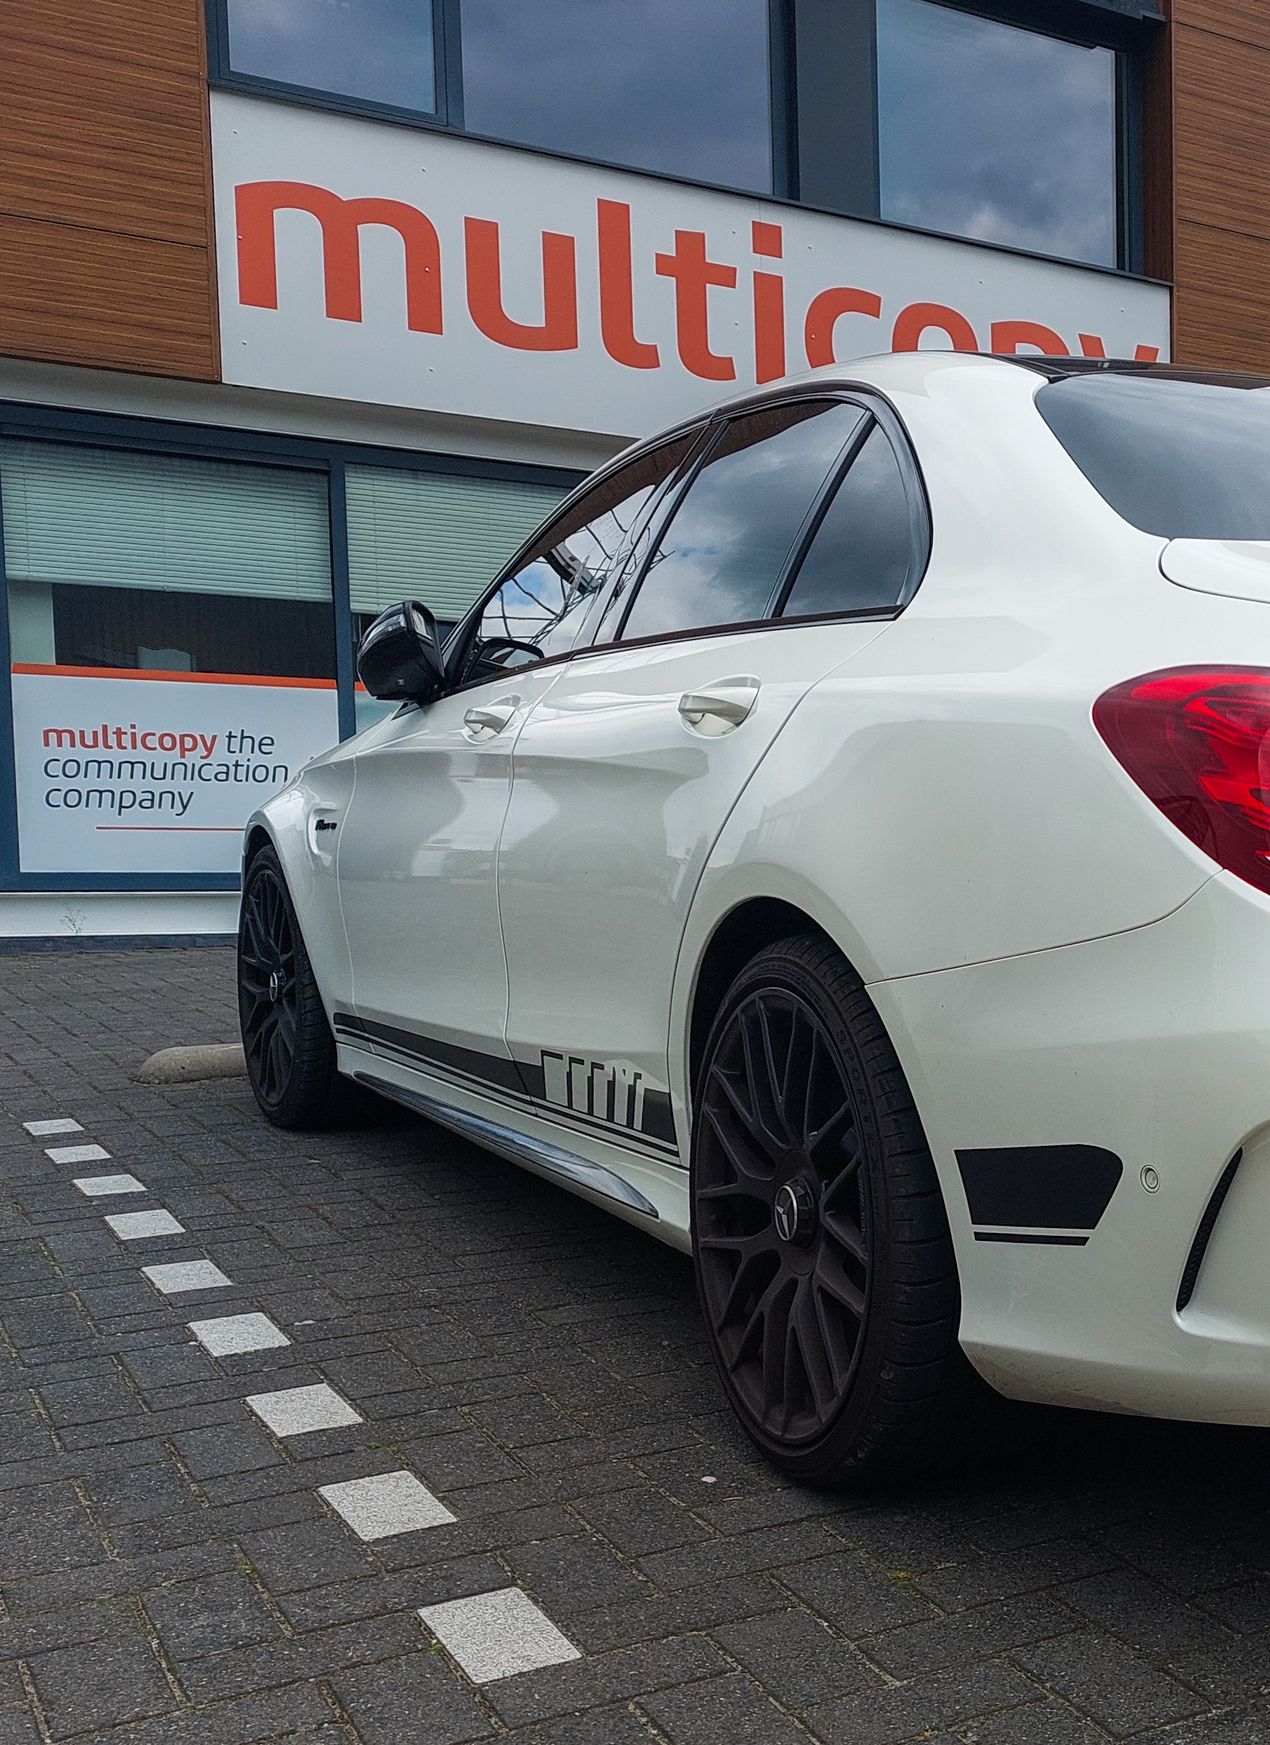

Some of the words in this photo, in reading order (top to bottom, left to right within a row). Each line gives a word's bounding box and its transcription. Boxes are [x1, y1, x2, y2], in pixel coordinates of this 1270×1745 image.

[234, 180, 1159, 385] multic
[42, 724, 218, 760] multicopy
[225, 729, 275, 755] the
[43, 757, 289, 784] communication
[44, 787, 195, 816] company
